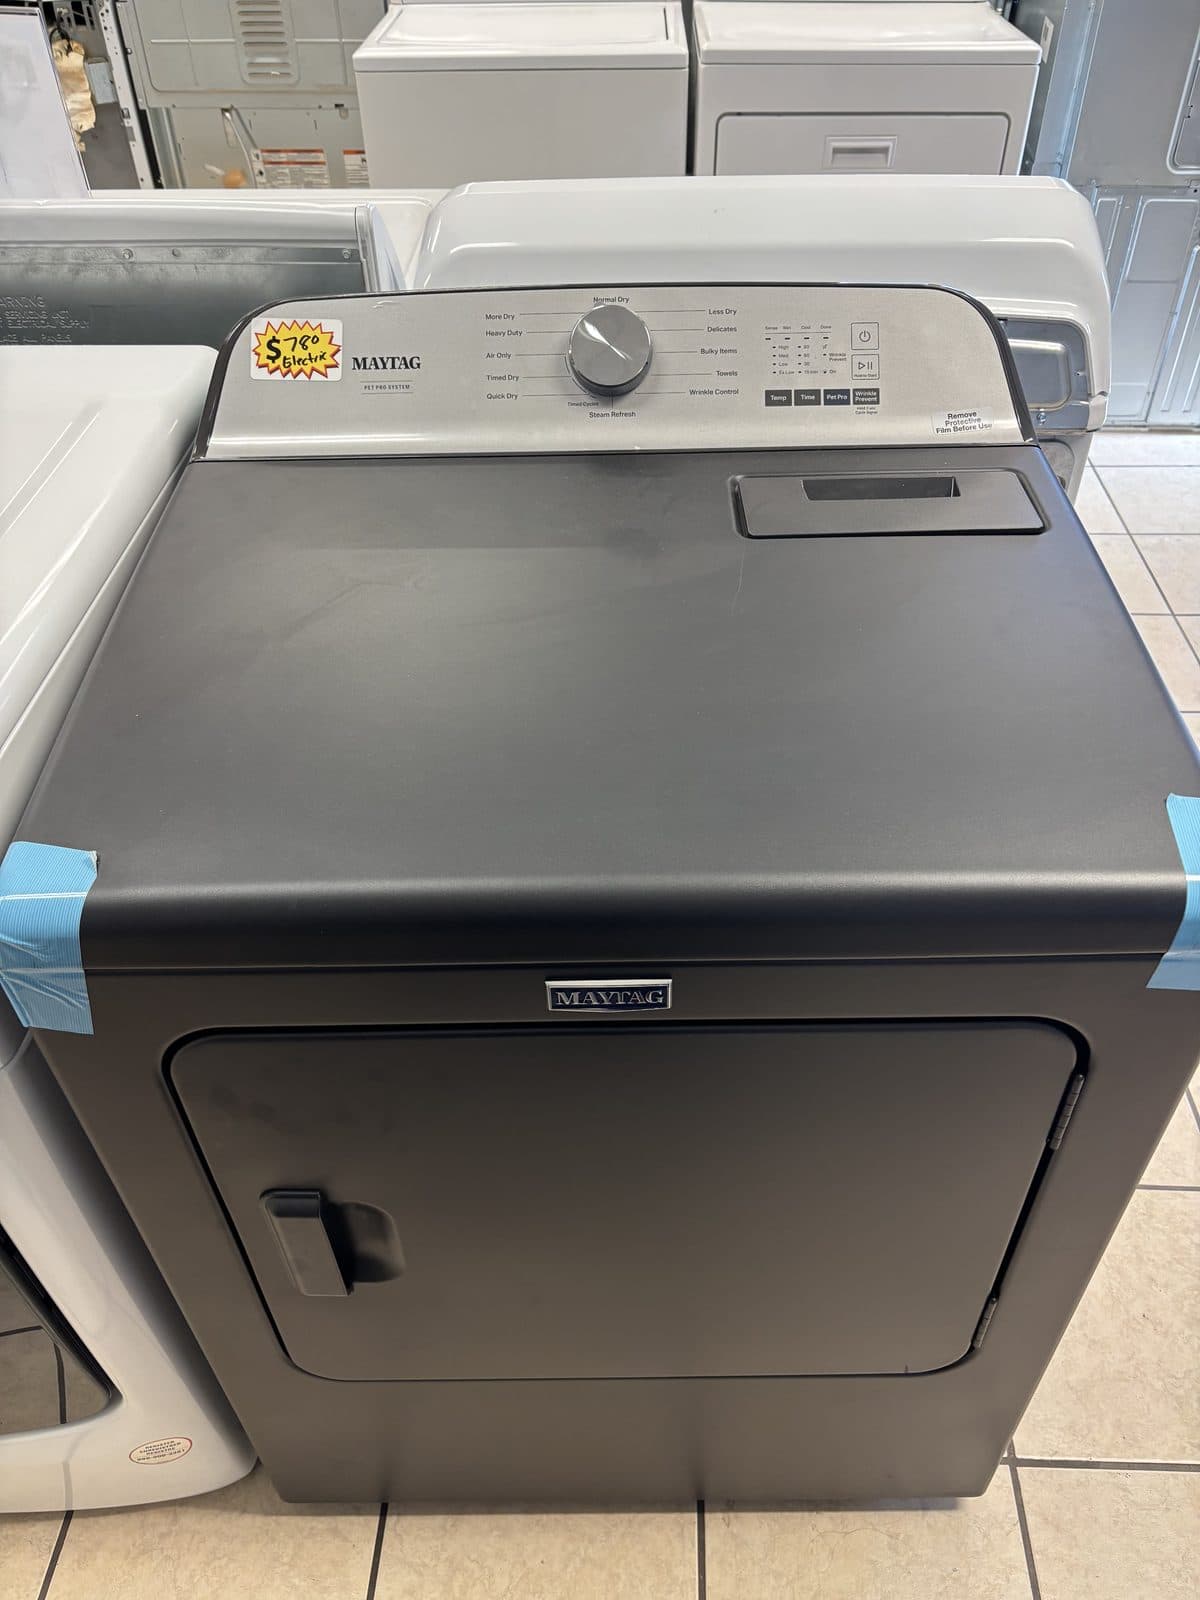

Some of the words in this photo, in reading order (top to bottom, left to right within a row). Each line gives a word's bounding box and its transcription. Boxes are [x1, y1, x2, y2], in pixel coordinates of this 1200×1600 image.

[507, 329, 523, 337] Duty
[352, 356, 421, 371] MAYTAG
[714, 387, 739, 395] Control
[947, 411, 977, 420] Remove
[945, 417, 982, 427] Protective
[952, 424, 977, 432] Before
[978, 422, 993, 430] Use
[556, 991, 664, 1005] MAYTAG
